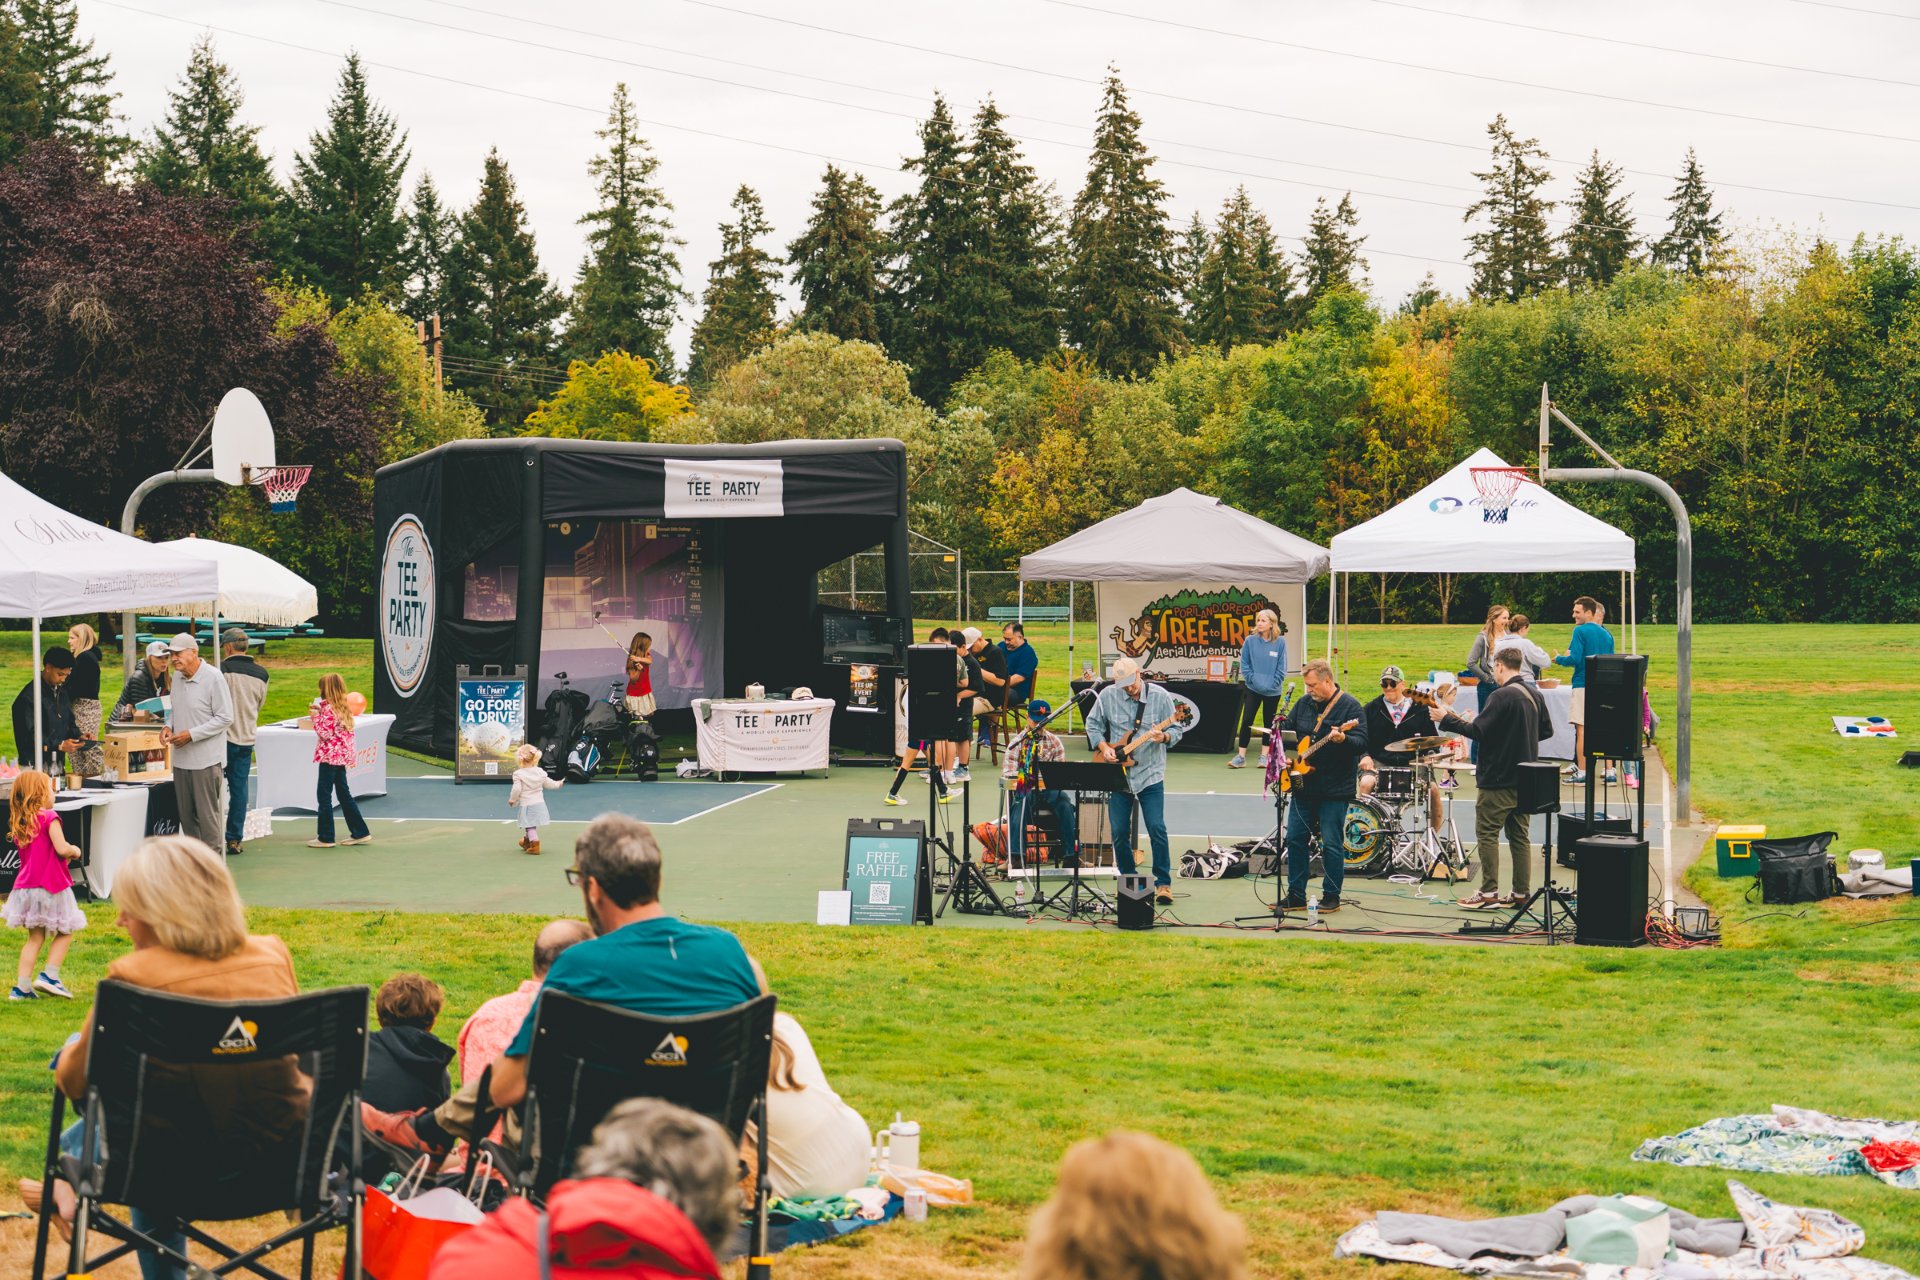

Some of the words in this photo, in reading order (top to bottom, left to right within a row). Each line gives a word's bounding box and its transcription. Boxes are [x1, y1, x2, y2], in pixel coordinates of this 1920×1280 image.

[687, 481, 711, 496] TEE
[723, 481, 760, 496] PARTY
[401, 536, 414, 558] The
[83, 573, 138, 595] Authentically
[397, 561, 418, 597] TEE
[1222, 600, 1264, 616] OREGON
[389, 598, 427, 639] PARTY
[1152, 609, 1209, 645] TREE
[1209, 628, 1220, 637] to
[1214, 611, 1258, 646] TRE
[1156, 644, 1187, 658] Aerial
[477, 687, 487, 695] TEE
[491, 687, 506, 695] PARTY
[854, 689, 873, 697] EVENT
[465, 699, 485, 711] GO
[487, 699, 520, 711] FORE
[466, 711, 476, 723] A
[478, 711, 519, 723] DRIVE.
[735, 715, 758, 728] TEE
[775, 713, 813, 727] PARTY
[866, 851, 901, 864] FREE
[856, 863, 909, 878] RAFFLE
